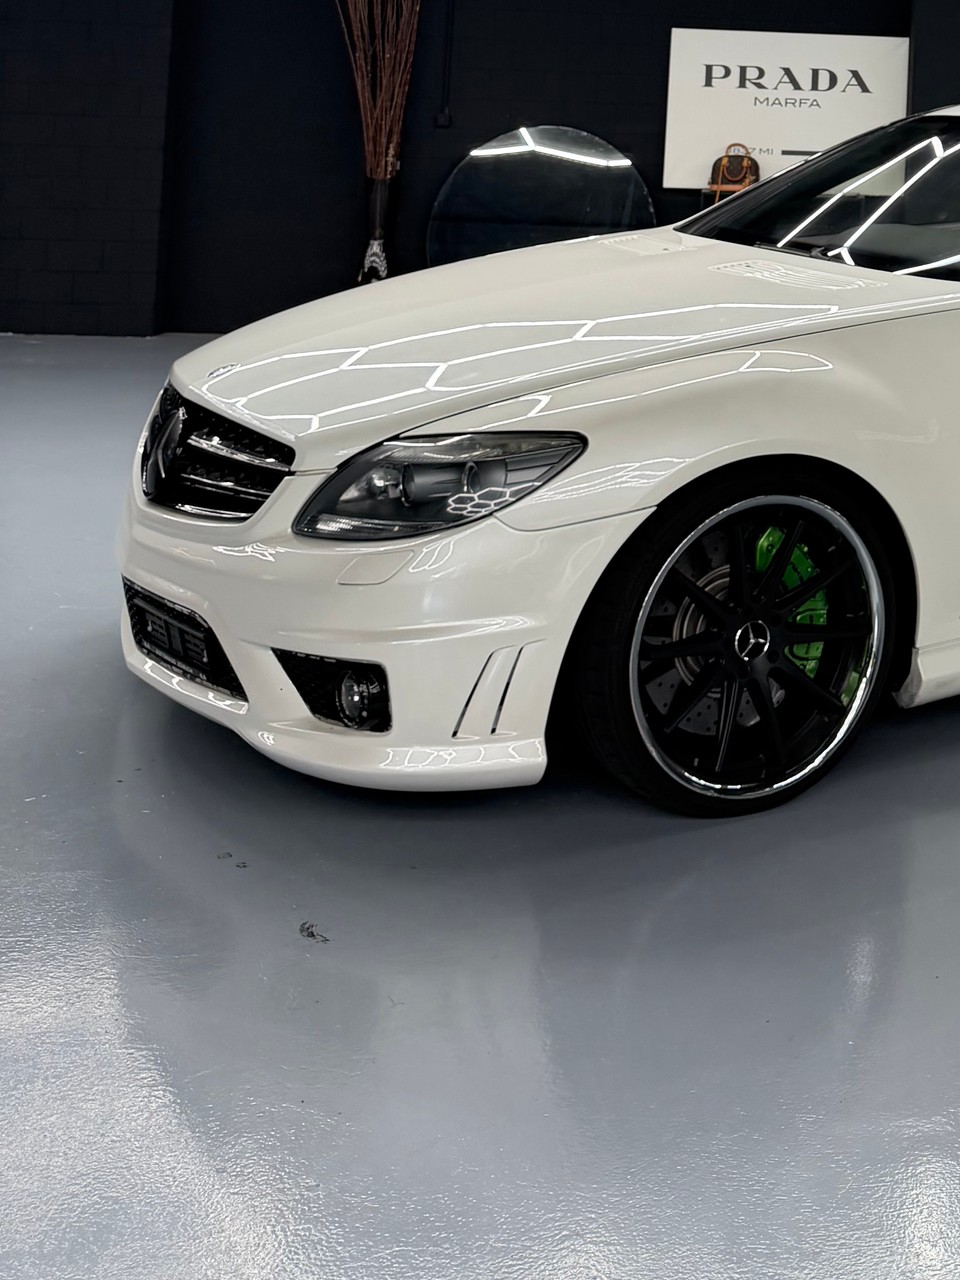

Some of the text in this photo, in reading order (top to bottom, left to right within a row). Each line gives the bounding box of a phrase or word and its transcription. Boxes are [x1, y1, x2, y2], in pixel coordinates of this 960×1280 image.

[702, 63, 873, 94] PRADA
[753, 96, 821, 109] MARFA
[758, 147, 774, 156] MI
